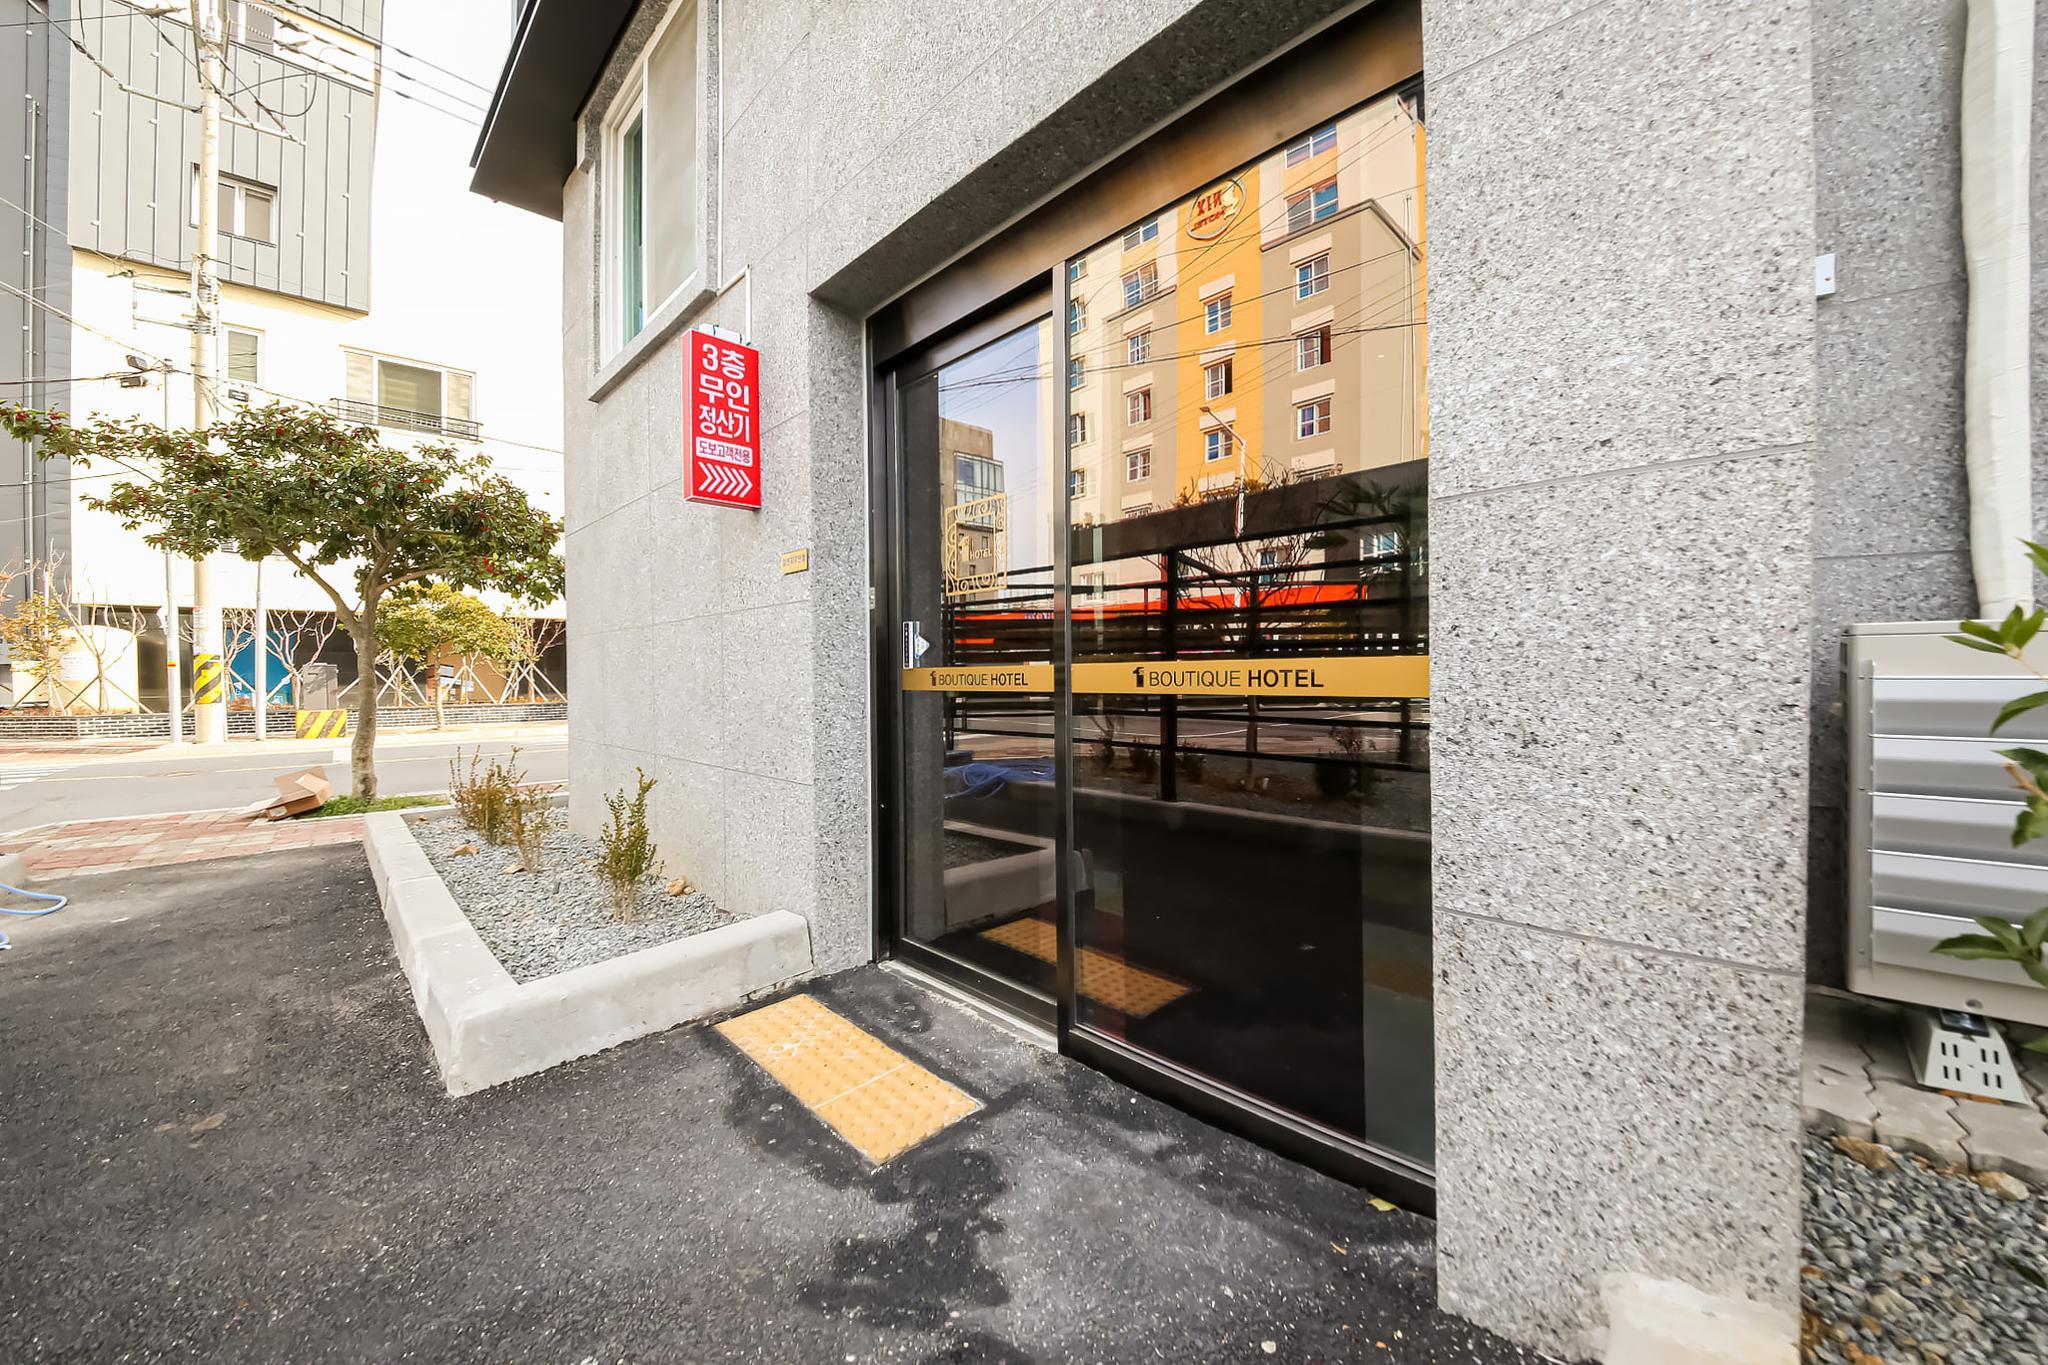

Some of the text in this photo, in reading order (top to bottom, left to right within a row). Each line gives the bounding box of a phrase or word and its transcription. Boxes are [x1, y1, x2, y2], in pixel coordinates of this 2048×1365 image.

[702, 343, 746, 380] 3층
[699, 373, 750, 413] 무인
[699, 404, 750, 443] 정산기
[699, 440, 751, 464] 도보고객전용
[970, 549, 993, 560] HOTEL
[938, 672, 1029, 686] BOUTIQUE HOTEL
[1149, 669, 1324, 688] BOUTIQUE HOTEL
